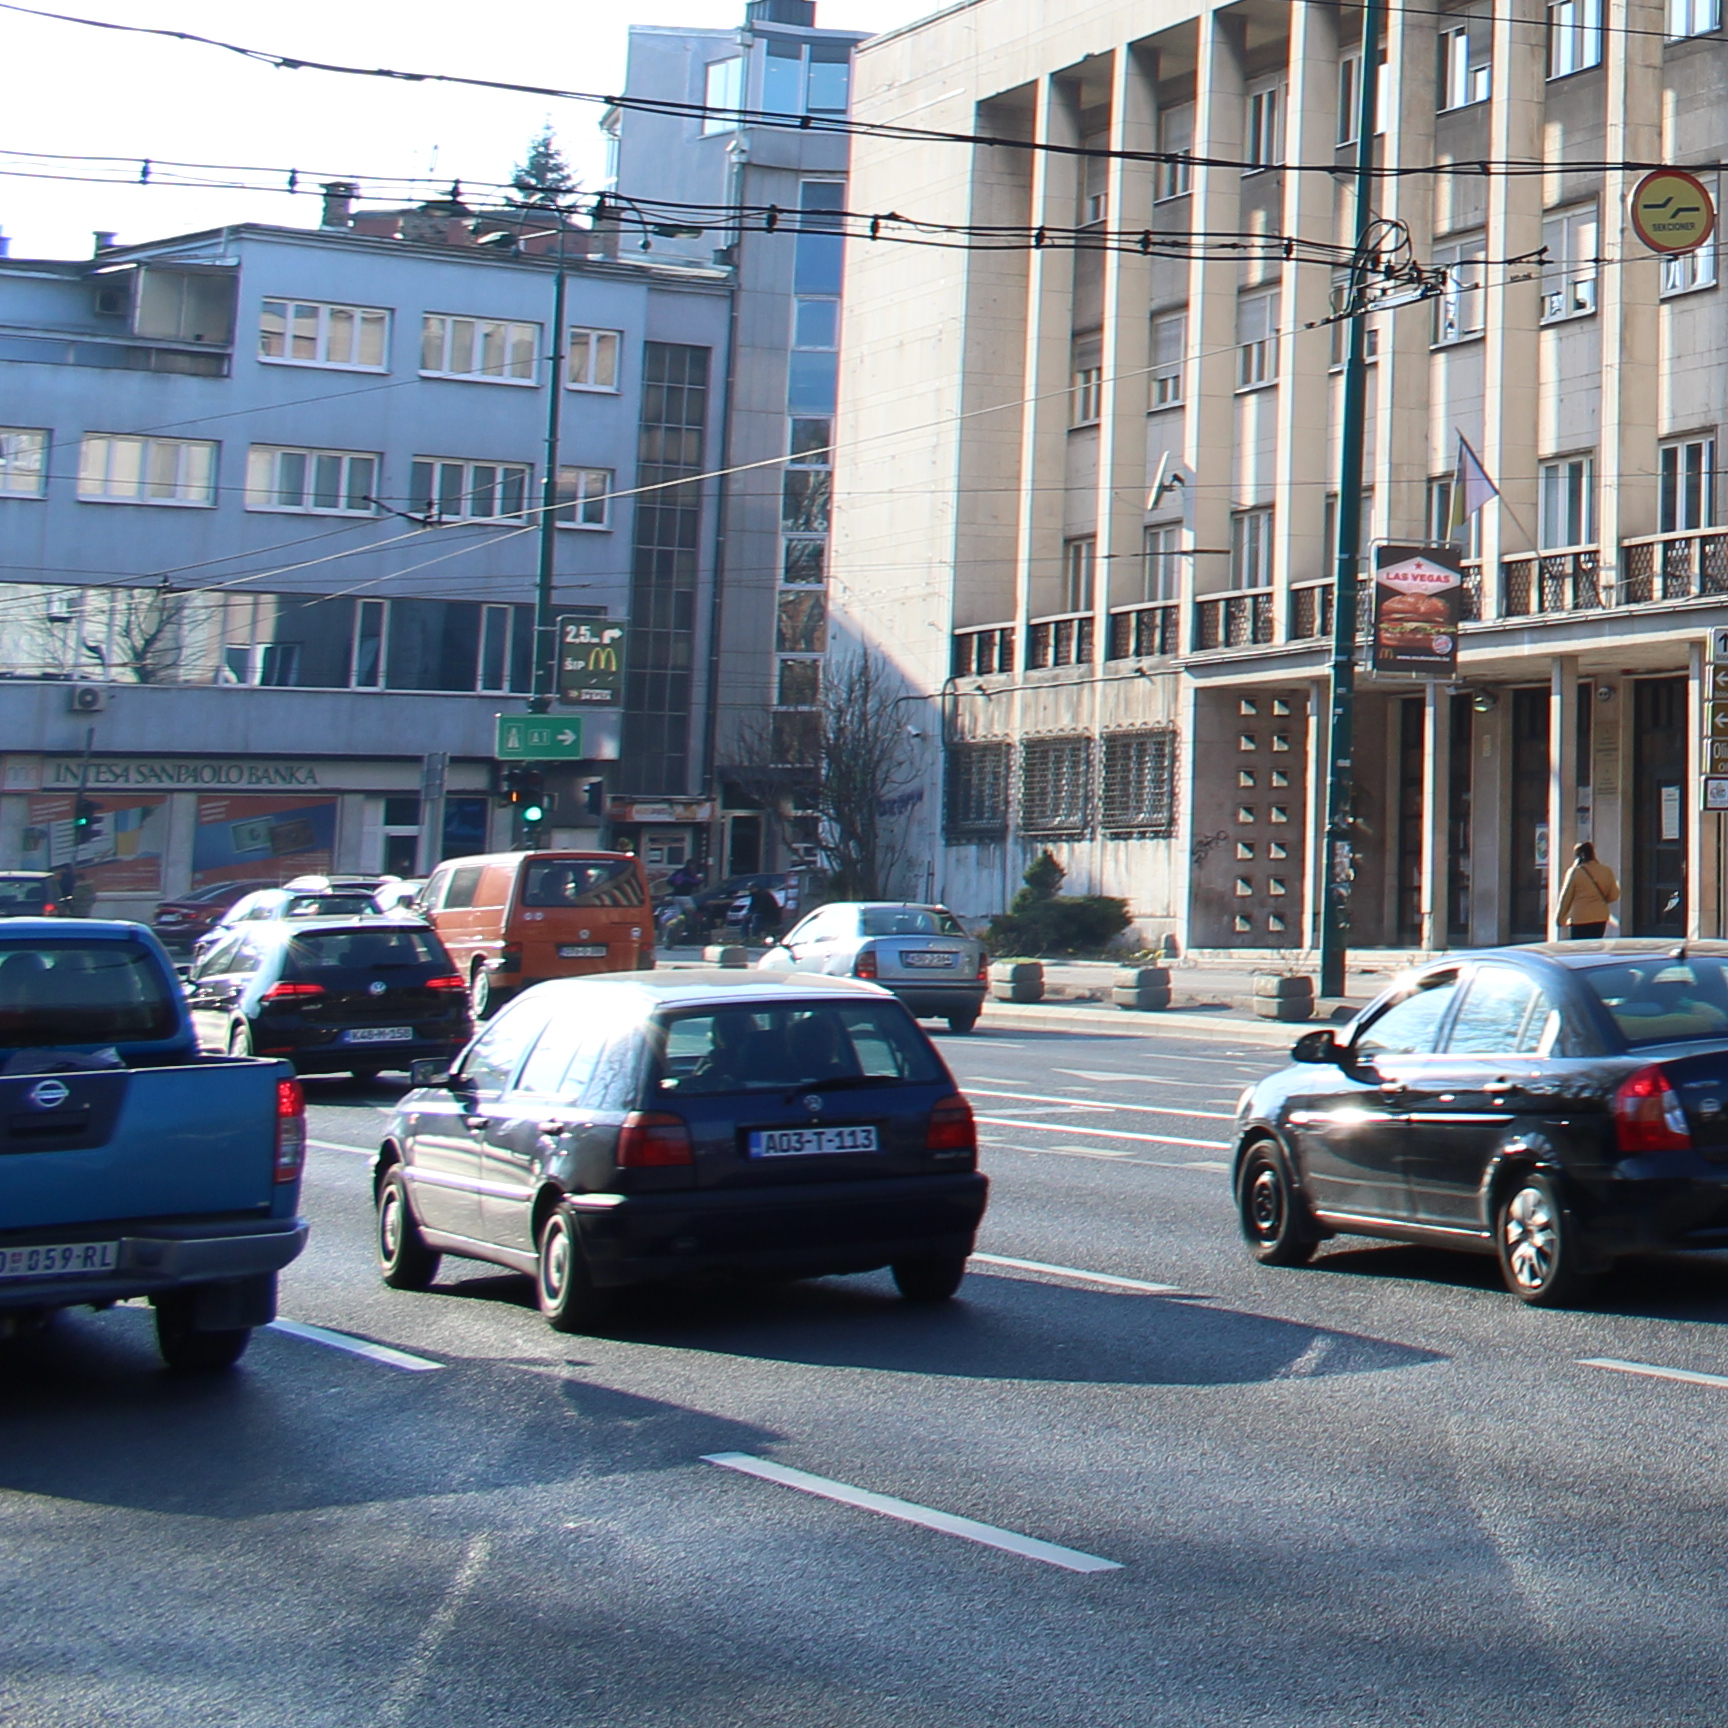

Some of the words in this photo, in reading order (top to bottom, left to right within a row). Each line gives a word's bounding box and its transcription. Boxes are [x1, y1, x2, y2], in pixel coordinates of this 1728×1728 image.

[1652, 221, 1696, 232] SEKCIONER
[1386, 571, 1409, 582] LAS
[1411, 573, 1451, 583] VEGAS
[55, 763, 131, 784] INTESA
[135, 763, 244, 785] SANPAOLO
[249, 765, 318, 785] BANKA
[765, 1128, 875, 1156] A03-T-113
